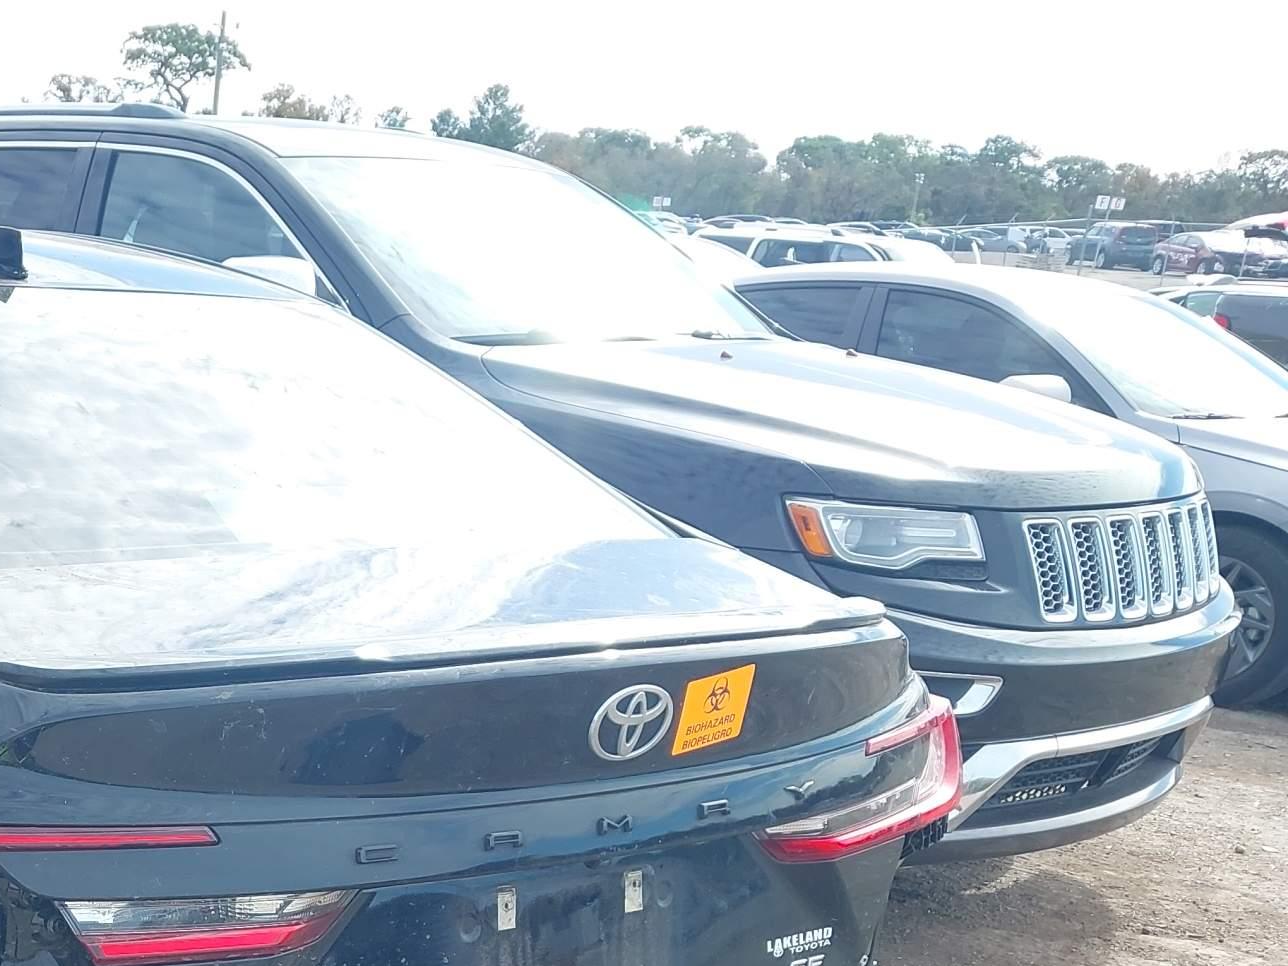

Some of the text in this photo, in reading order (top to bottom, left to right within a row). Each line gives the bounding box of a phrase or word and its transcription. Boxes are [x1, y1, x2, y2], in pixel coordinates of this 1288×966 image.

[686, 714, 735, 735] BIOHAZARD
[682, 727, 733, 749] BIOPELIGRO
[355, 778, 815, 865] CAMRY
[766, 926, 833, 957] LAKELAND
[790, 939, 831, 954] TOYOTA
